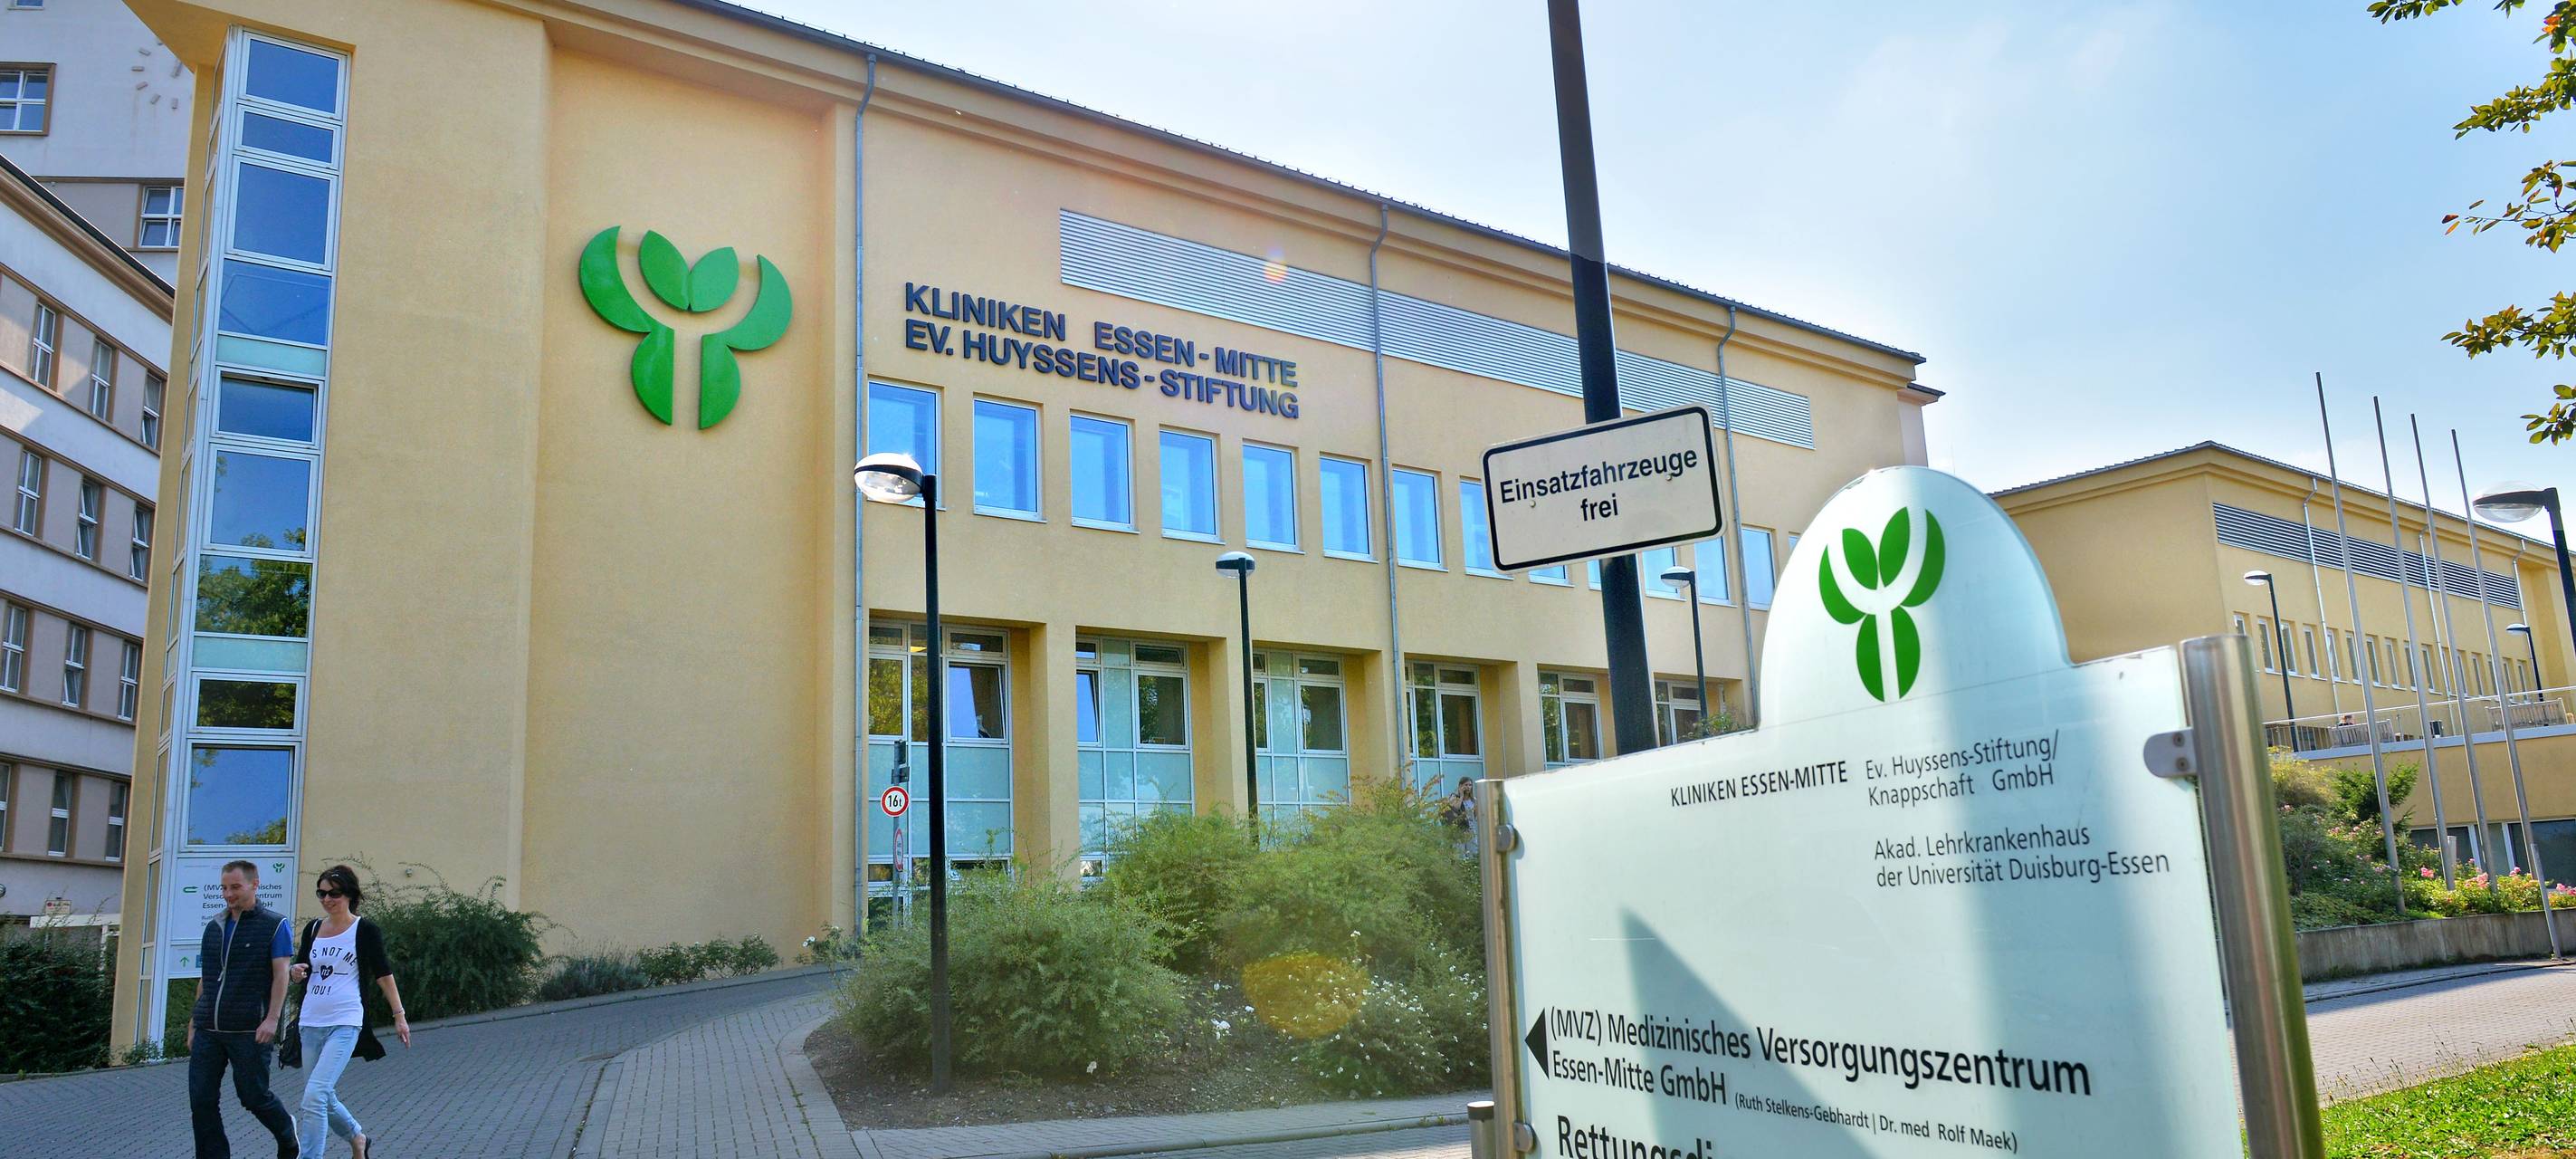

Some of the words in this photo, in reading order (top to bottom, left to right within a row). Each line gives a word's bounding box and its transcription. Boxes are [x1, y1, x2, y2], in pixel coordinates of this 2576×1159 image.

[905, 282, 1066, 341] KLINIKEN
[905, 318, 954, 356] EV.
[1500, 449, 1697, 503] Einsatzfahrzeuge
[1580, 493, 1618, 522] frei
[1865, 760, 1888, 780] Ev.
[1892, 729, 2059, 779] Huyssens-Stiftung/
[1671, 778, 1736, 807] KLINIKEN
[1741, 761, 1848, 797] ESSEN-MITTE
[1868, 772, 1975, 809] Knappschaft
[1992, 762, 2054, 790] GmbH
[1875, 837, 1921, 860] Akad.
[1926, 824, 2090, 857] Lehrkrankenhaus
[1876, 867, 1903, 887] der
[1907, 859, 2003, 886] Universität
[2008, 851, 2170, 884] Duisburg-Essen
[321, 947, 342, 957] NOT
[1550, 1006, 1602, 1046] (MVZ)
[1608, 1013, 1751, 1058] Medizinisches
[1757, 1027, 2092, 1096] Versorgungszentrum
[1552, 1050, 1655, 1093] Essen-Mitte
[1660, 1064, 1727, 1105] GmbH
[1735, 1092, 1763, 1112] (Ruth
[1766, 1097, 1870, 1129] Stelkens-Gebhardt
[1880, 1115, 1898, 1134] Dr.
[1901, 1120, 1930, 1138] med
[1938, 1123, 1968, 1144] Rolf
[1970, 1128, 2018, 1154] Maek)
